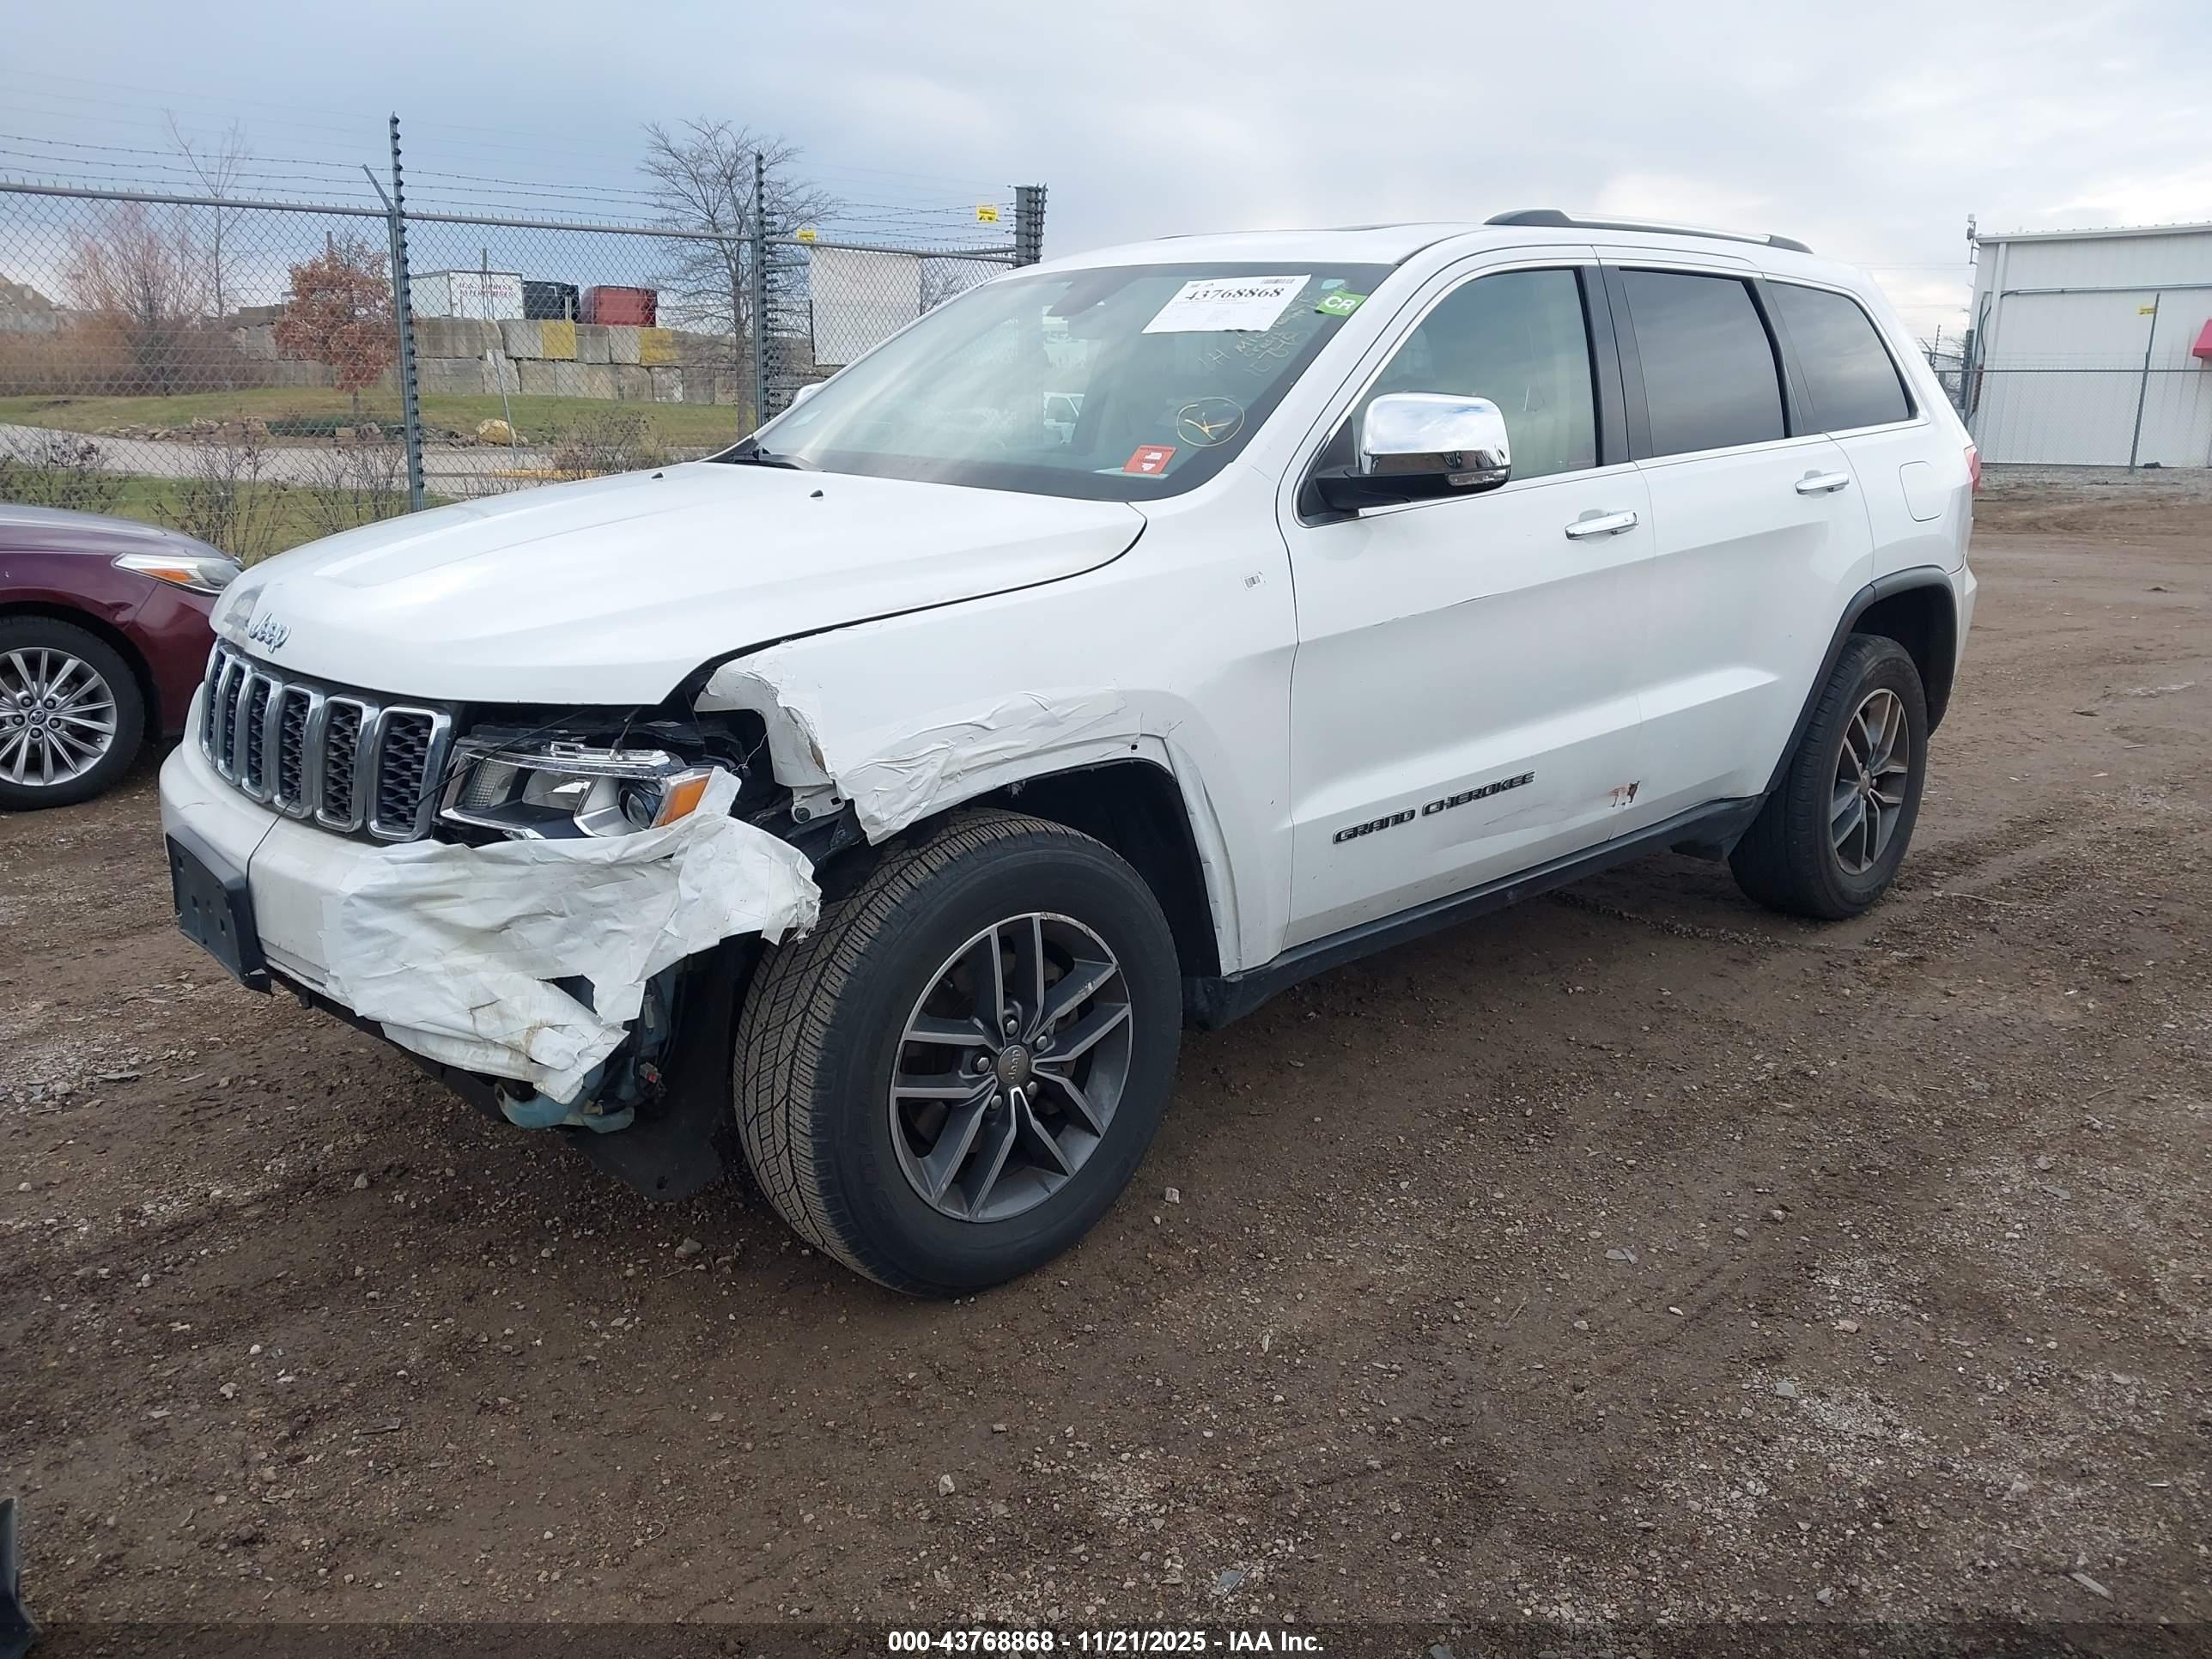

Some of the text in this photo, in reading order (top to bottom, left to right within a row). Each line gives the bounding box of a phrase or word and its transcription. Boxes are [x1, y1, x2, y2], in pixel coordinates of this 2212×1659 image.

[1185, 287, 1285, 301] 43768868
[1325, 296, 1356, 310] CR
[248, 612, 291, 653] Jeep
[1333, 770, 1535, 844] GRAND CHEROKEE
